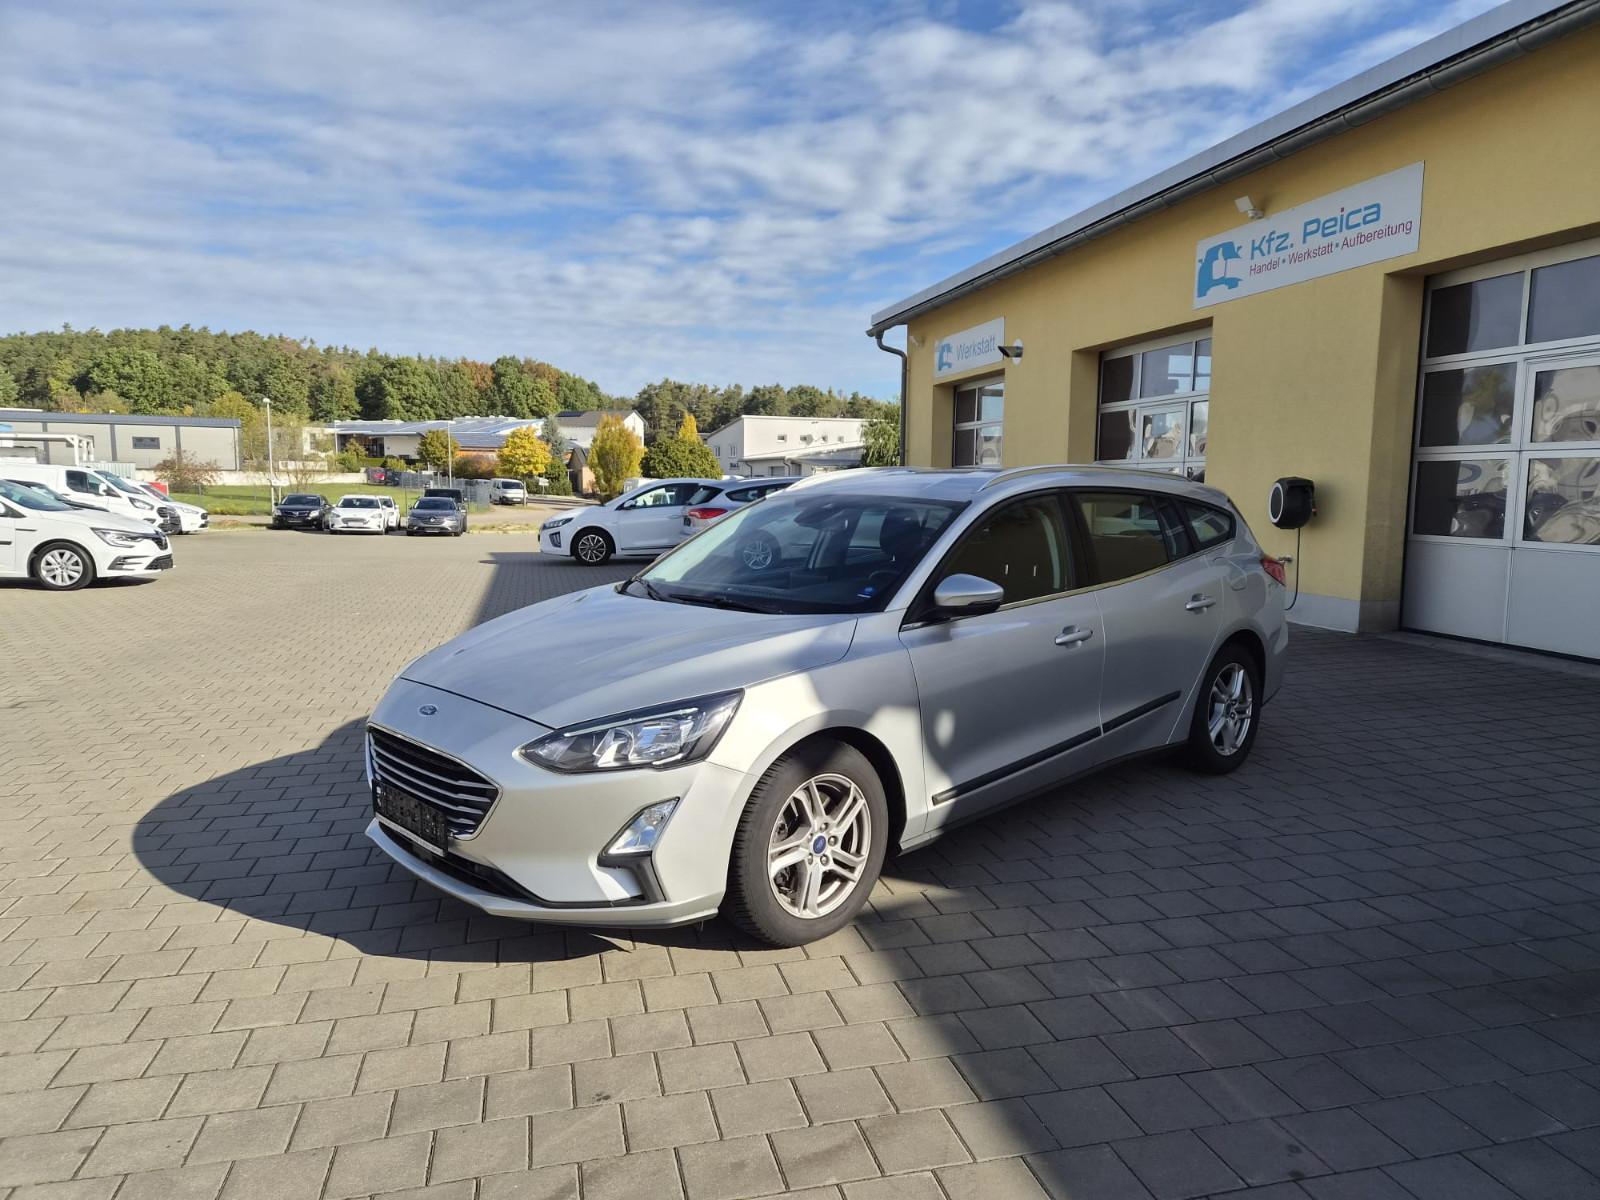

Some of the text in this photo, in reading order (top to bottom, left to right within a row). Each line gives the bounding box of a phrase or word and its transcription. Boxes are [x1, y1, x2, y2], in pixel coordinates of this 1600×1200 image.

[1250, 203, 1381, 260] Kfz. Peica
[1250, 220, 1413, 276] Handel Werkstatt Aufbereitung
[956, 336, 997, 360] Werkstatt
